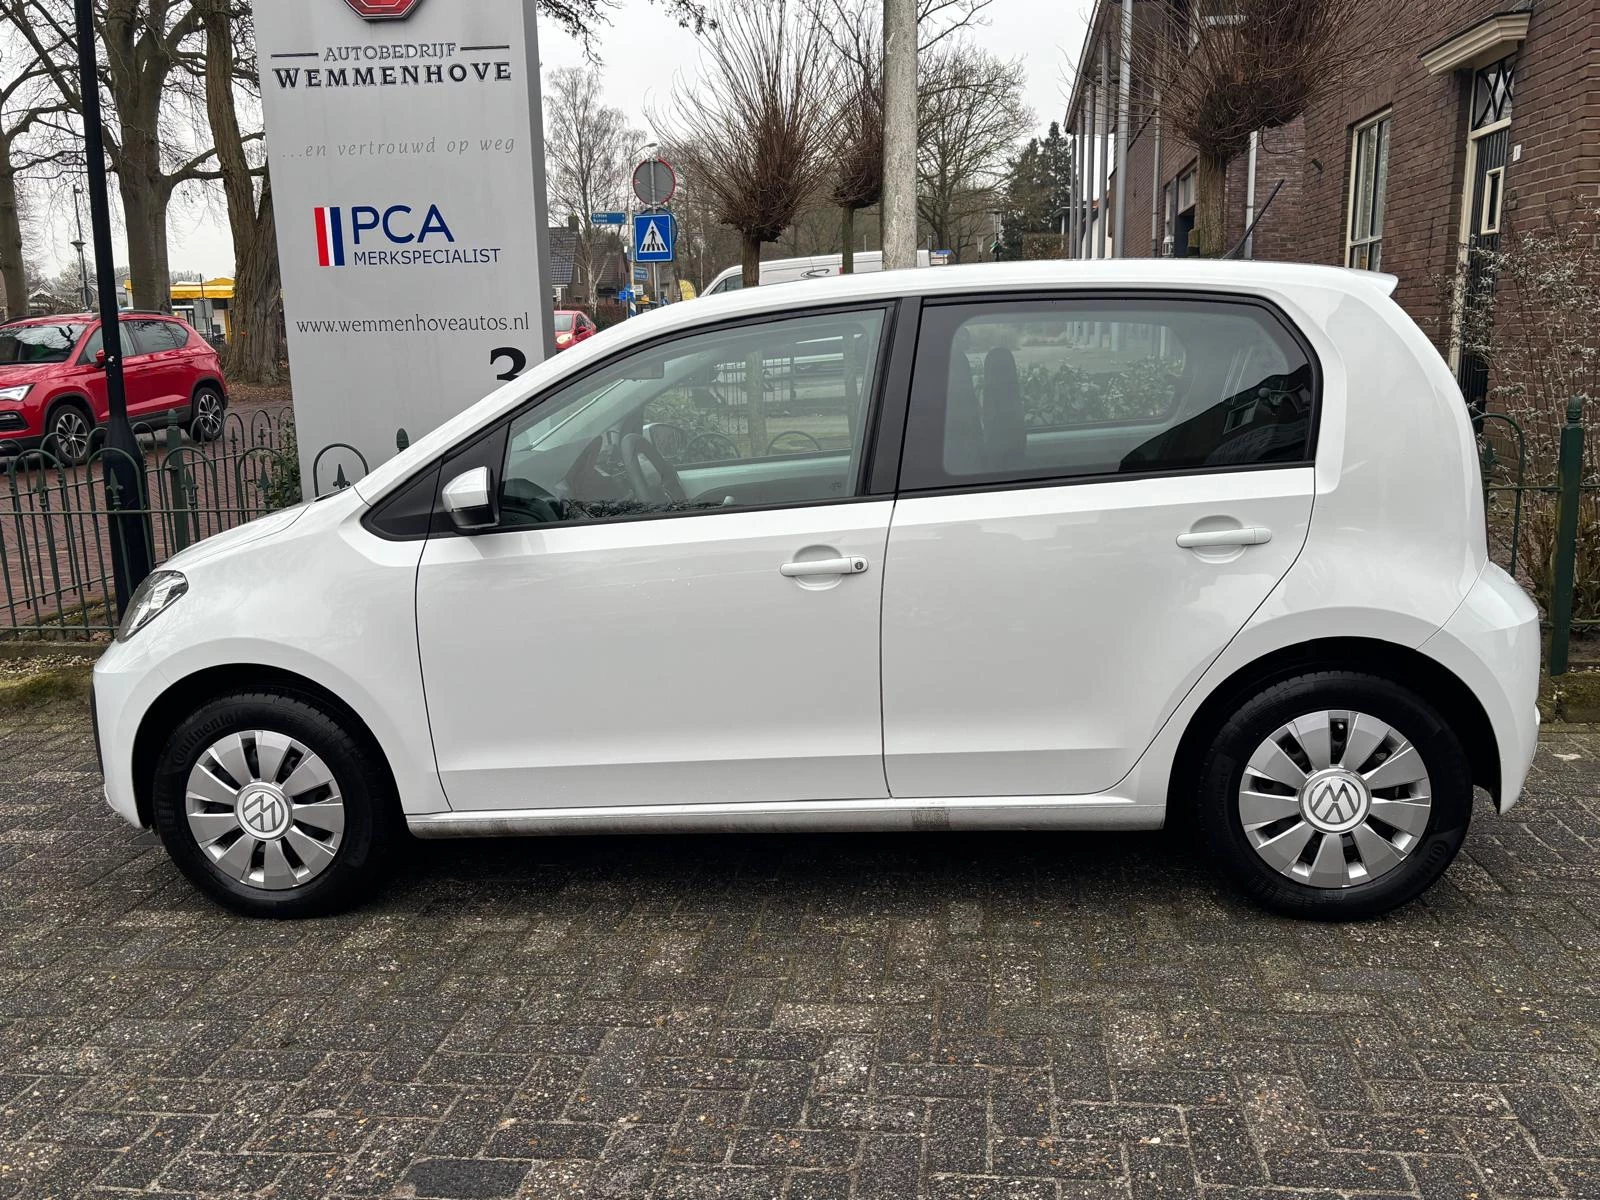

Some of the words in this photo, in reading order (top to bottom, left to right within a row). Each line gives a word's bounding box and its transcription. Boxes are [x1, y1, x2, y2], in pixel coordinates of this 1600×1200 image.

[323, 42, 456, 62] AUTOBEDRIJF
[271, 61, 512, 89] WEMMENHOVE
[338, 136, 436, 156] vertrouwd
[447, 139, 470, 155] op
[480, 138, 516, 153] weg
[351, 203, 455, 244] PCA
[353, 248, 502, 266] MERKSPECIALIST
[296, 312, 530, 333] www.wemmenhoveautos.nl
